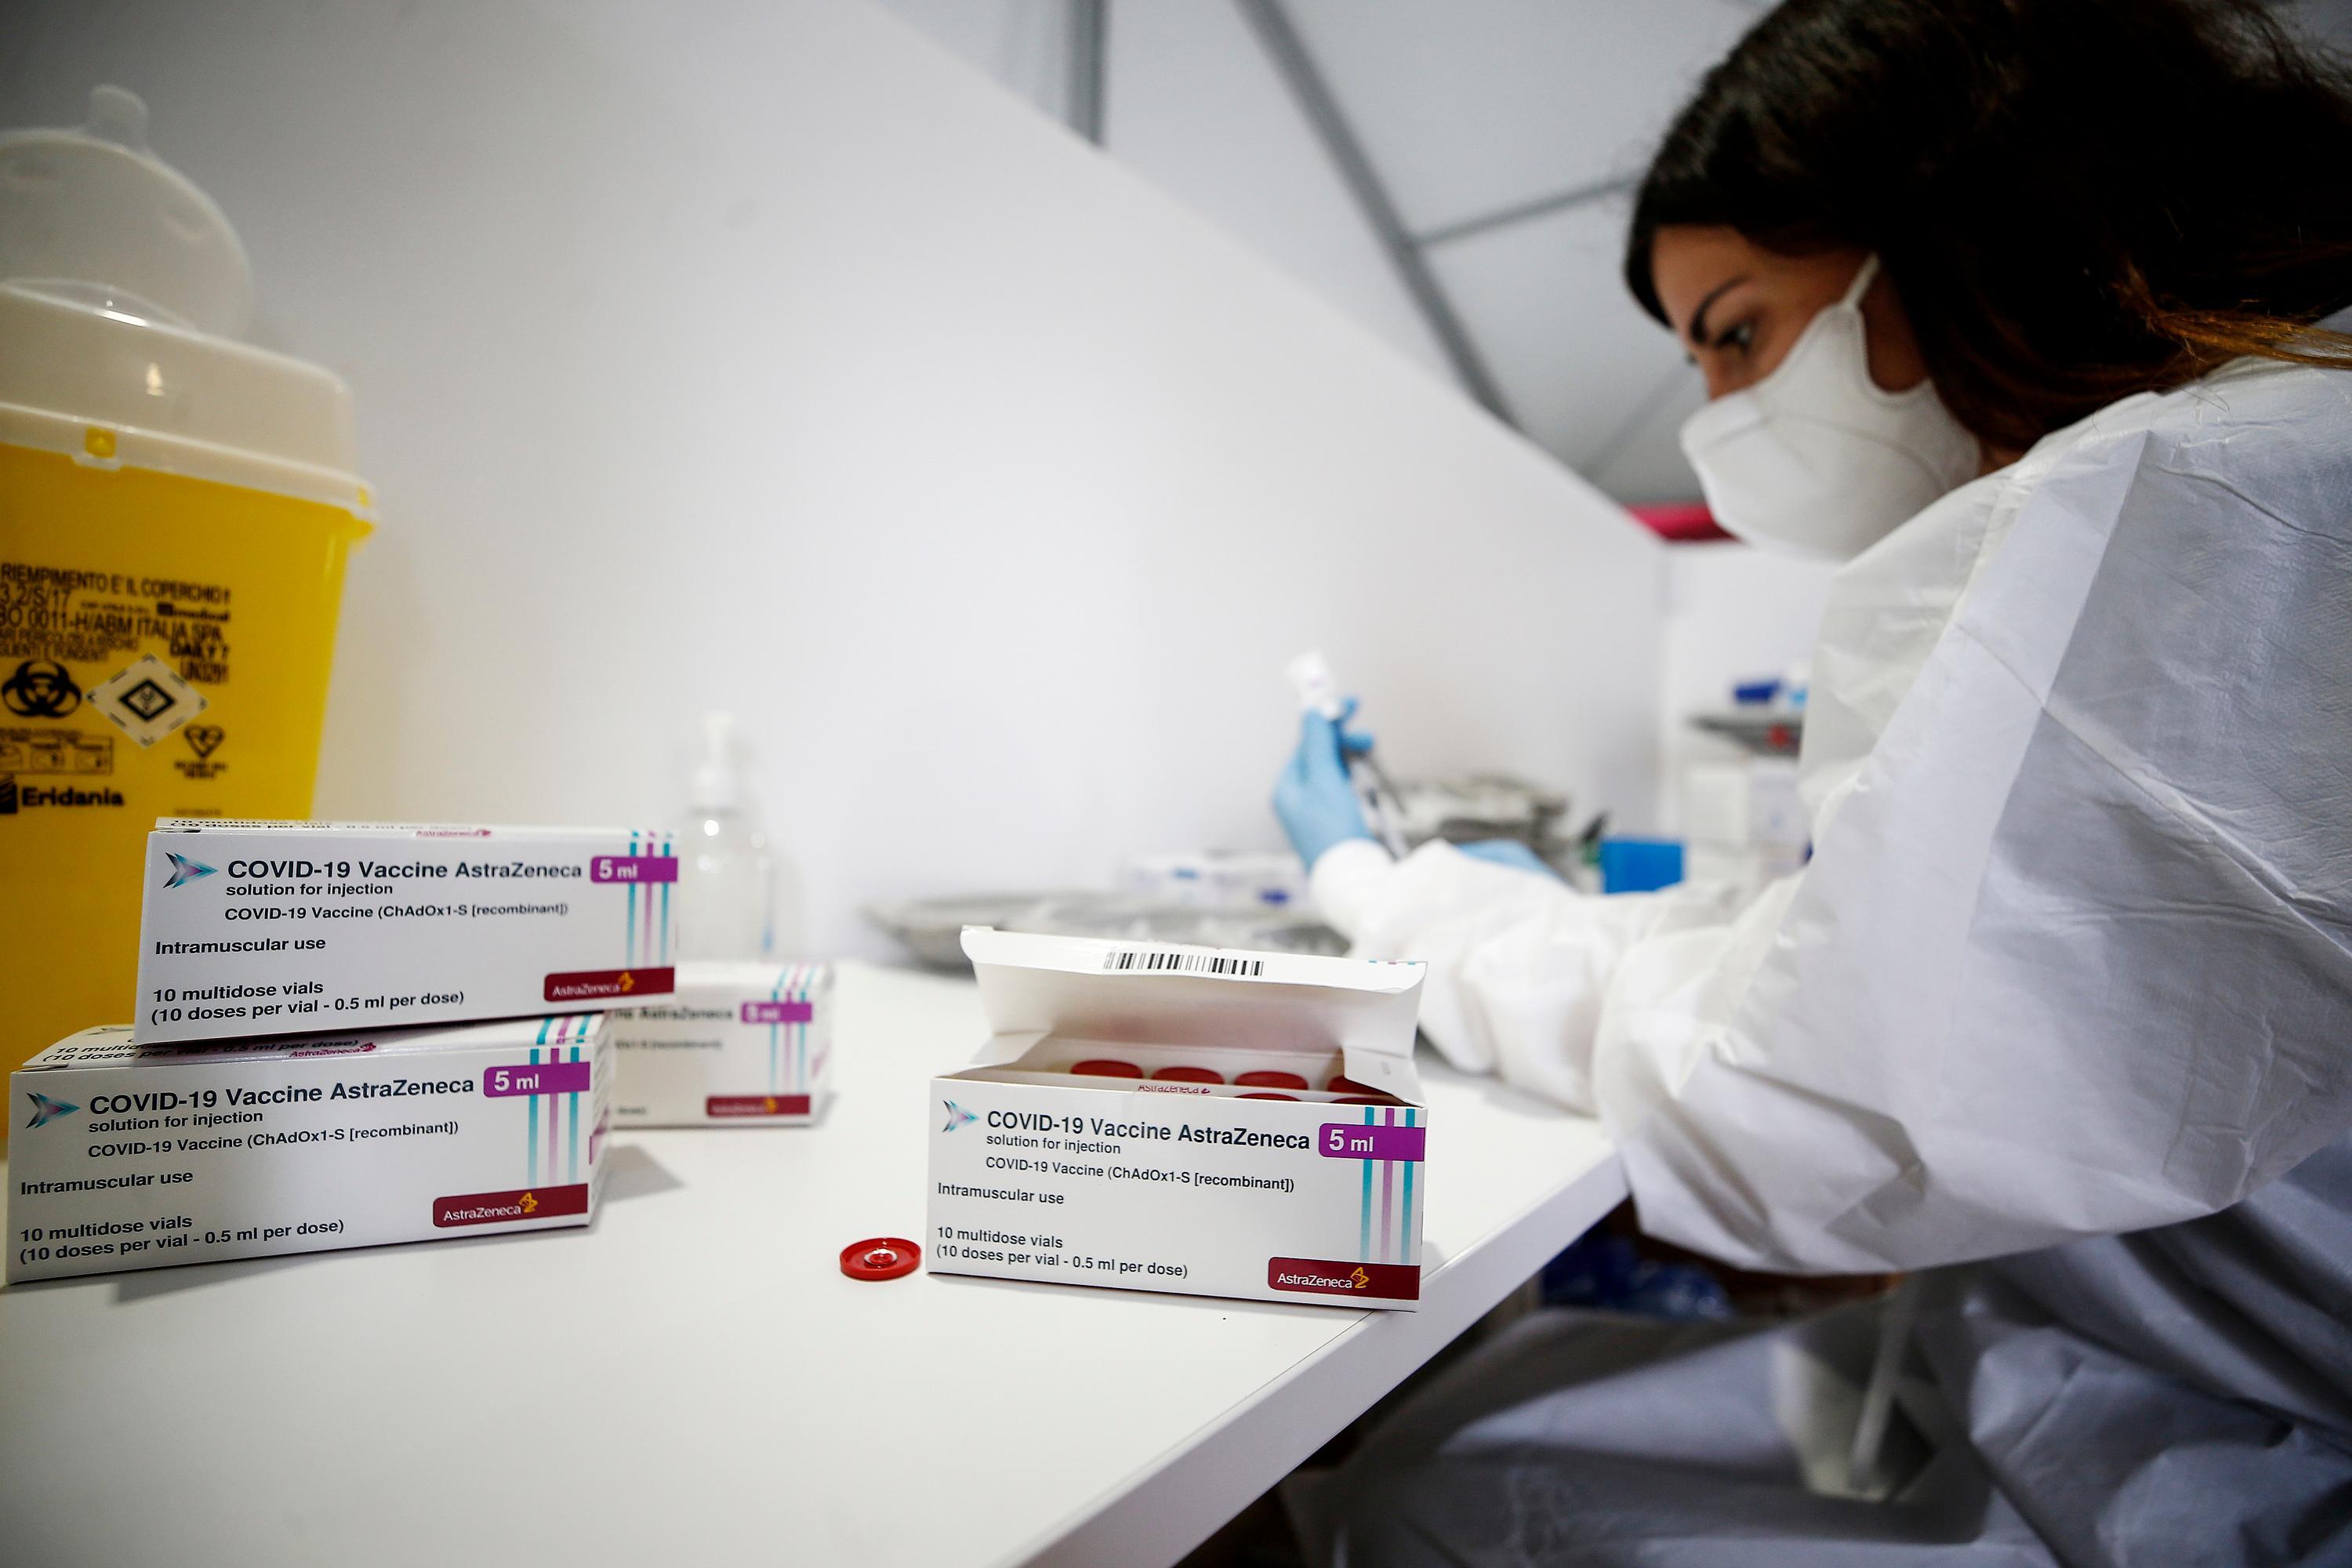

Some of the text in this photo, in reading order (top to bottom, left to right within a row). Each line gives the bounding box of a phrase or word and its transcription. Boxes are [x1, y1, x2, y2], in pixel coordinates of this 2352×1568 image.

[1, 562, 107, 593] RIEMPIMENTO
[127, 577, 137, 597] IL
[136, 615, 188, 644] ITALIA
[22, 786, 125, 807] Eridania
[228, 860, 637, 880] COVID-19 Vaccine AstraZeneca 5 ml
[226, 884, 393, 897] solution for injection
[225, 903, 568, 920] COVID-19 Vaccine (ChAdOx1-S [recombinant])
[156, 938, 325, 954] Intramuscular use
[154, 982, 323, 1002] 10 multidose vials
[552, 983, 621, 996] AstraZeneca
[151, 1008, 182, 1025] (10
[188, 1007, 246, 1020] doses
[252, 1005, 282, 1019] per
[288, 1000, 318, 1013] vial
[335, 997, 359, 1010] 0.5
[365, 996, 384, 1008] ml
[390, 996, 416, 1010] per
[421, 991, 463, 1004] dose)
[43, 1054, 75, 1062] (10
[78, 1051, 132, 1061] doses
[137, 1049, 172, 1058] per
[223, 1044, 250, 1053] 0.5
[252, 1043, 276, 1051] ml
[278, 1042, 310, 1051] per
[312, 1039, 359, 1047] dose)
[289, 1047, 361, 1058] AstraZeneca
[90, 1073, 540, 1114] COVID-19 Vaccine AstraZeneca 5 ml
[89, 1112, 263, 1132] solution for injection
[988, 1111, 1374, 1152] COVID-19 Vaccine AstraZeneca 5 ml
[89, 1121, 458, 1157] COVID-19 Vaccine (ChAdOx1-S [recombinant])
[986, 1134, 1120, 1154] solution for injection
[21, 1173, 193, 1195] Intramuscular use
[986, 1157, 1294, 1192] COVID-19 Vaccine (ChAdOx1-S [recombinant])
[938, 1182, 1064, 1204] Intramuscular use
[443, 1205, 521, 1221] AstraZeneca
[21, 1216, 192, 1242] 10 multidose vials
[938, 1227, 1062, 1248] 10 multidose vials
[20, 1247, 49, 1265] (10
[56, 1244, 114, 1258] doses
[121, 1240, 151, 1255] per
[156, 1234, 187, 1248] vial
[205, 1230, 230, 1243] 0.5
[237, 1228, 257, 1240] ml
[264, 1227, 292, 1241] per
[297, 1219, 343, 1235] dose)
[937, 1244, 956, 1258] (10
[962, 1247, 1003, 1261] doses
[1008, 1254, 1031, 1265] per
[1035, 1254, 1058, 1265] vial
[1073, 1256, 1093, 1269] 0.5
[1098, 1259, 1114, 1270] ml
[1120, 1263, 1143, 1274] per
[1148, 1262, 1187, 1279] dose)
[1277, 1272, 1352, 1290] AstraZeneca
